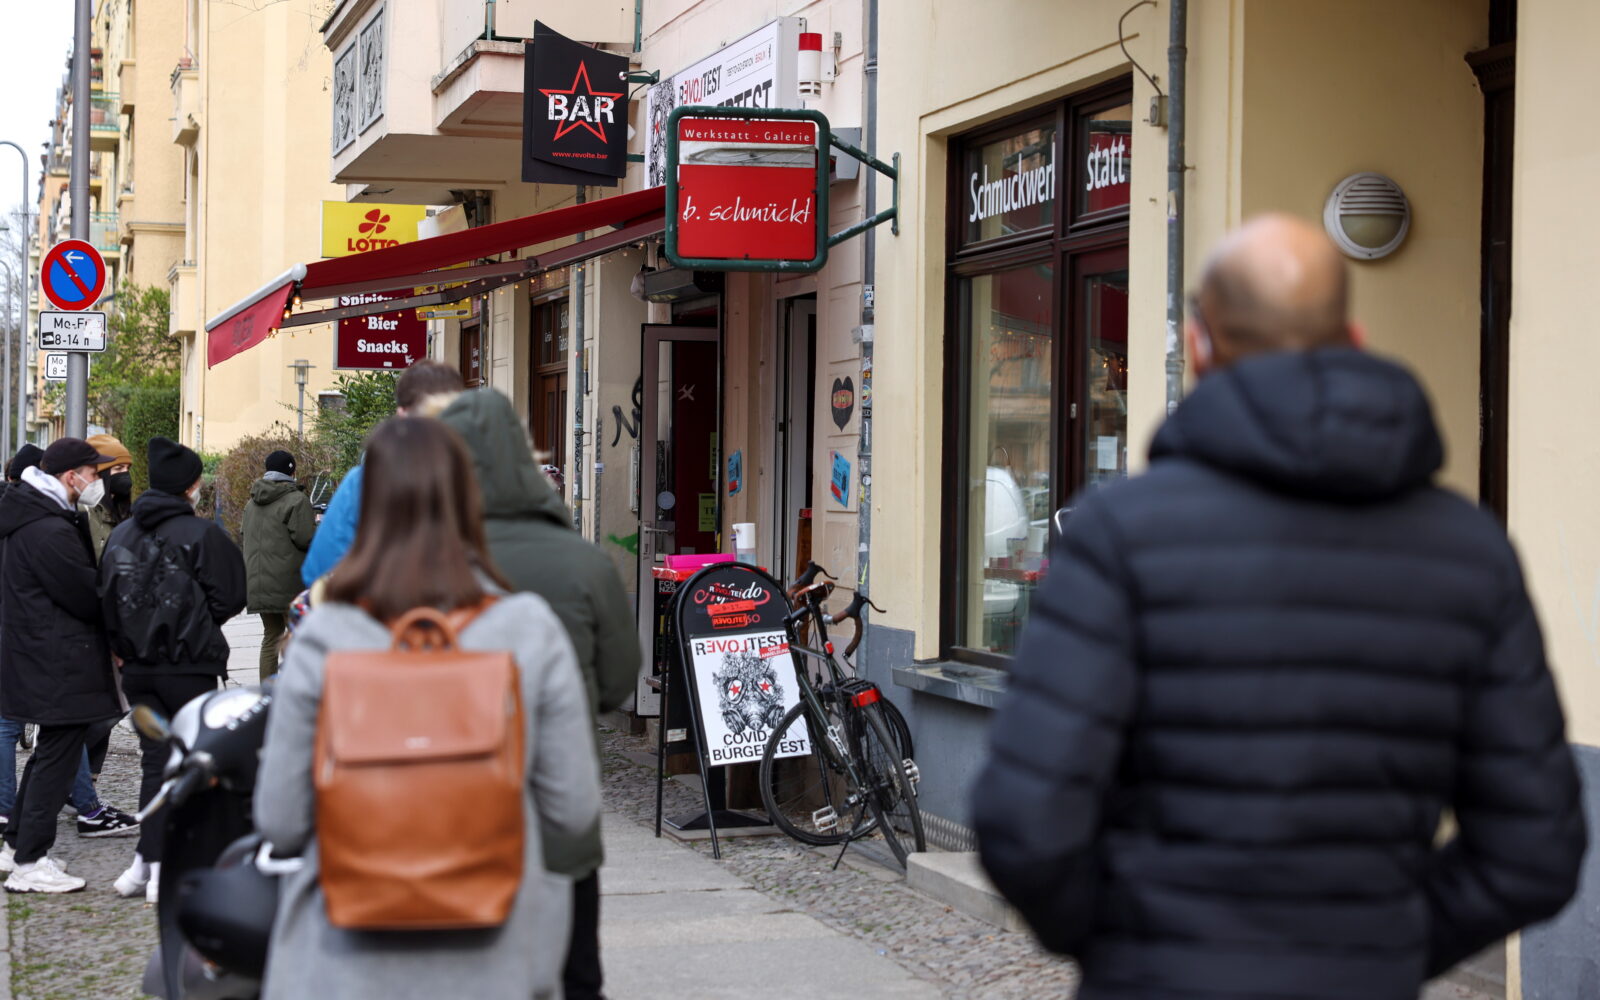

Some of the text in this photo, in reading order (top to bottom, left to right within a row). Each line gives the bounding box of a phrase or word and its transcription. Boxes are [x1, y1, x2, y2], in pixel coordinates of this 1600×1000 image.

[548, 94, 614, 123] BAR
[685, 129, 749, 139] Werkstatt
[764, 131, 810, 141] Galerie
[552, 151, 608, 159] www.revolte.bar
[1086, 136, 1125, 191] statt
[683, 195, 811, 224] b. schmückt
[368, 316, 398, 330] Bier
[55, 334, 79, 345] 8-14
[357, 339, 408, 353] Snacks
[723, 730, 787, 746] COVID-
[712, 740, 805, 760] BÜRGEEST
